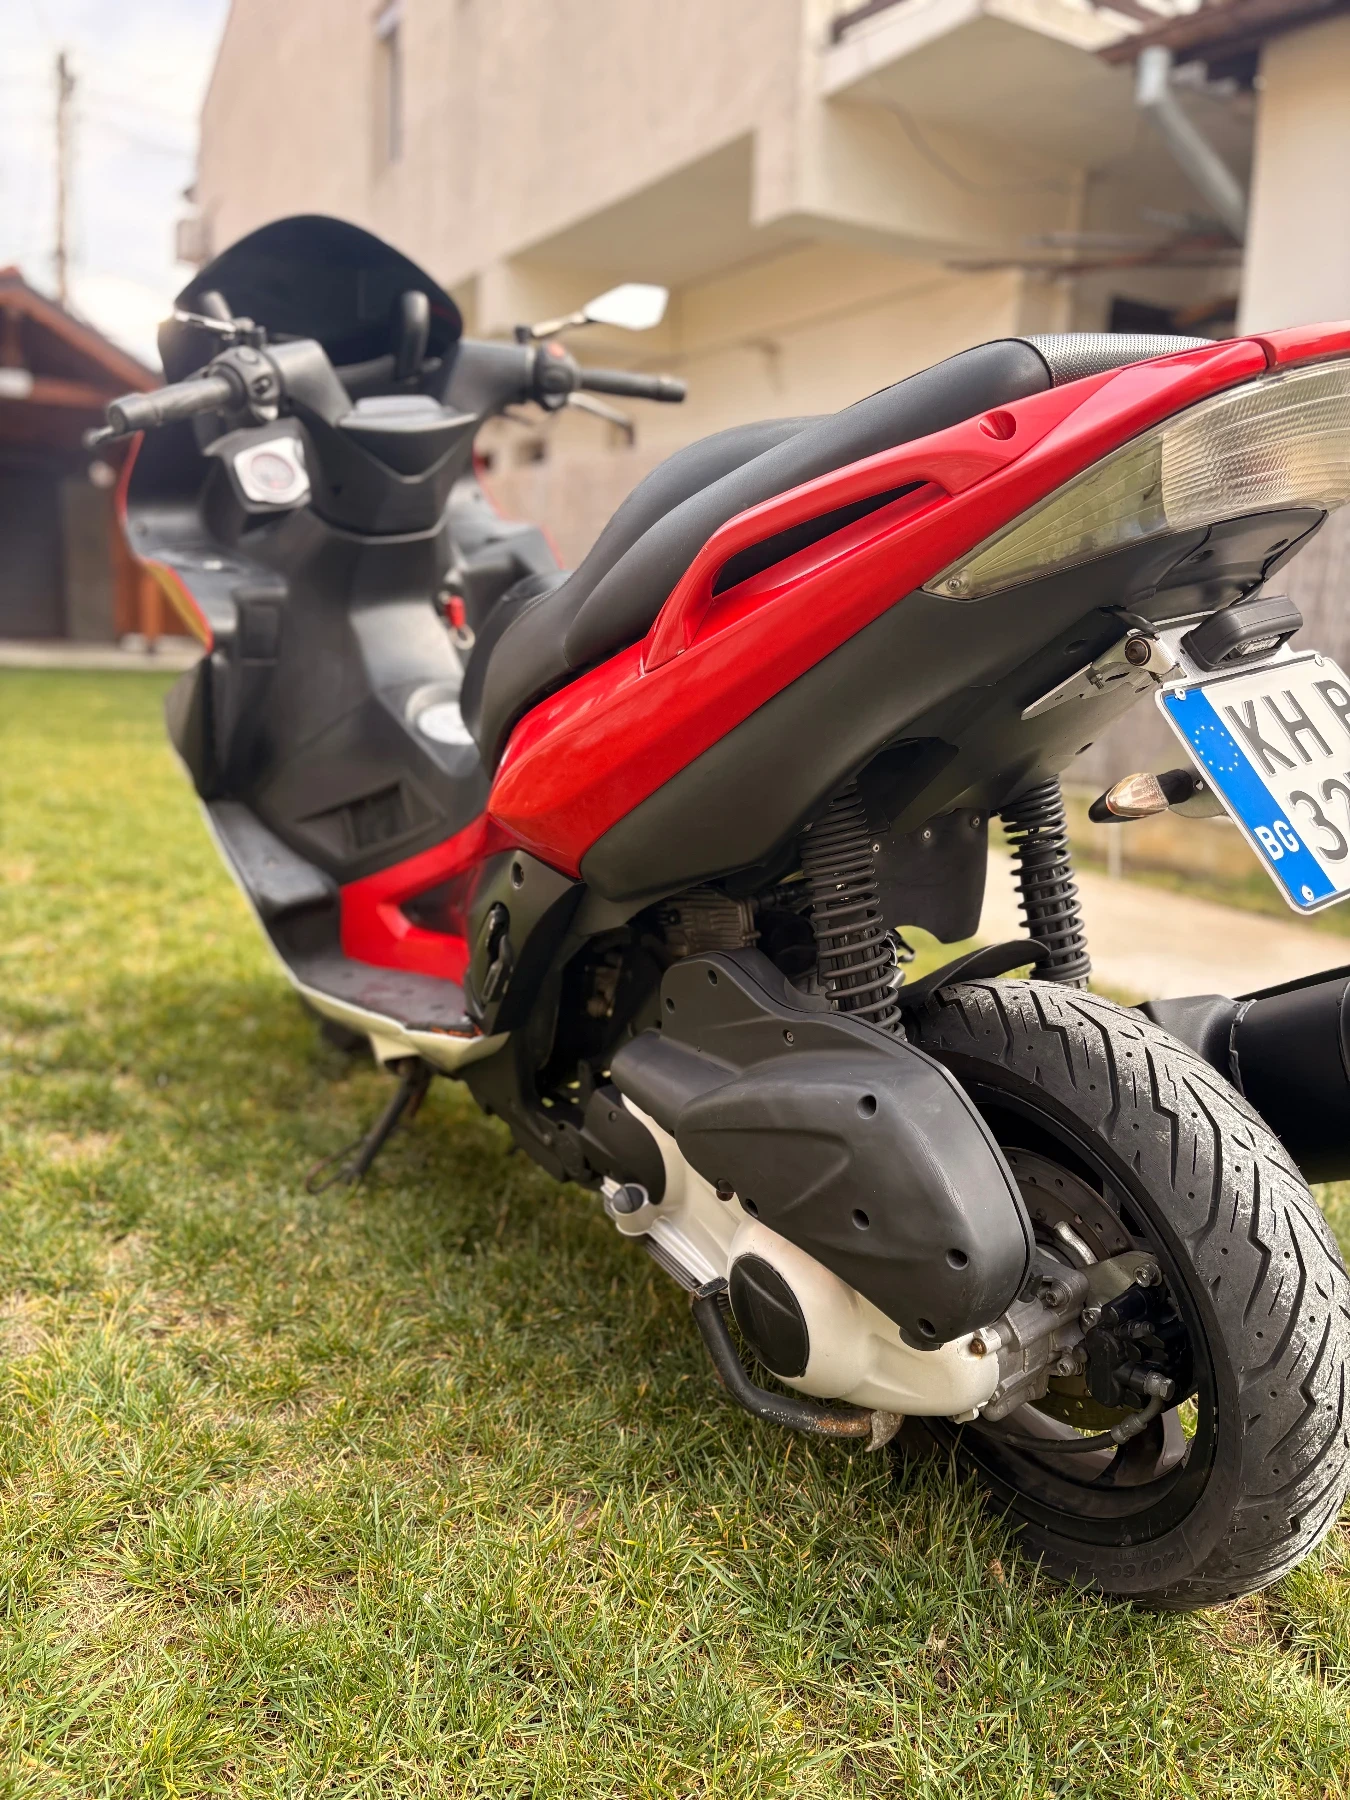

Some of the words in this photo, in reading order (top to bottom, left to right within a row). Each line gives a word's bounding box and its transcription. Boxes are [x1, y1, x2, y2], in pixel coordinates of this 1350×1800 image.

[1223, 689, 1335, 777] KH
[1254, 820, 1300, 861] BG
[1288, 771, 1350, 863] 32
